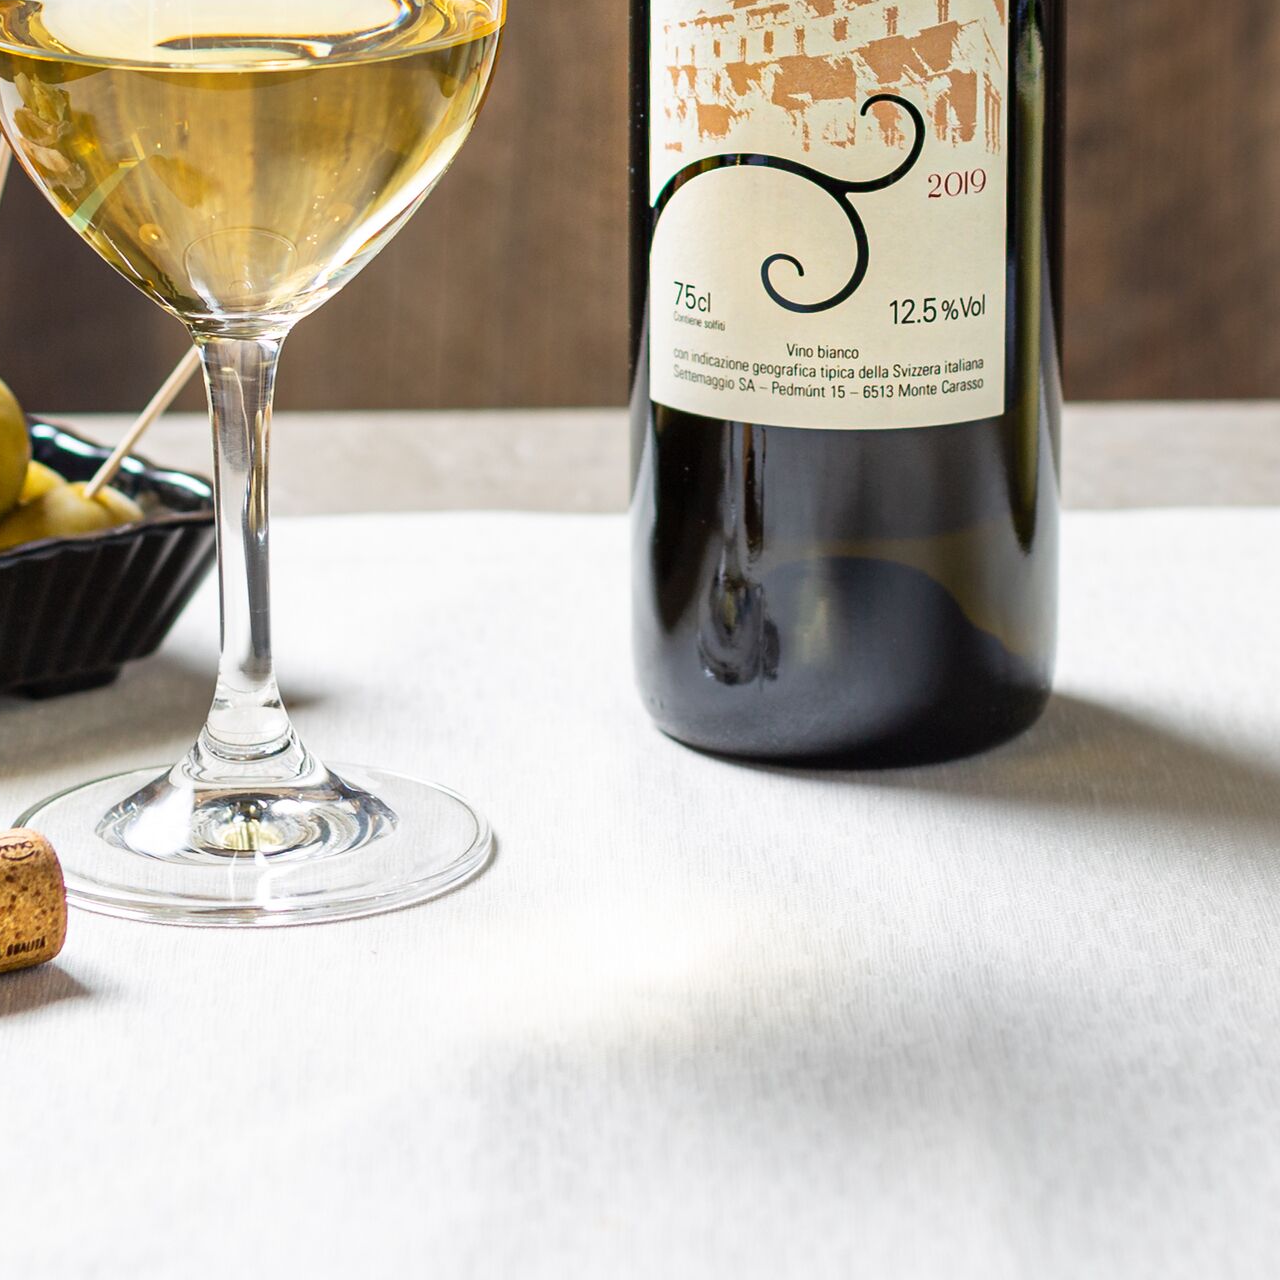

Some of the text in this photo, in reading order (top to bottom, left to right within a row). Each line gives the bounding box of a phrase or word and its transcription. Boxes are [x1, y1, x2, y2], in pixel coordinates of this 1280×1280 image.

[927, 168, 987, 199] 2019
[673, 281, 711, 313] 75cl
[889, 297, 938, 325] 12.5
[673, 348, 985, 382] con indicazione geografica tipica della Svizzera italiana
[786, 343, 860, 360] Vino bianco
[673, 364, 736, 391] Settemaggio
[738, 378, 756, 393] SA
[831, 385, 846, 400] 15
[863, 385, 894, 400] 6513
[898, 383, 938, 399] Monte
[941, 377, 985, 395] Carasso
